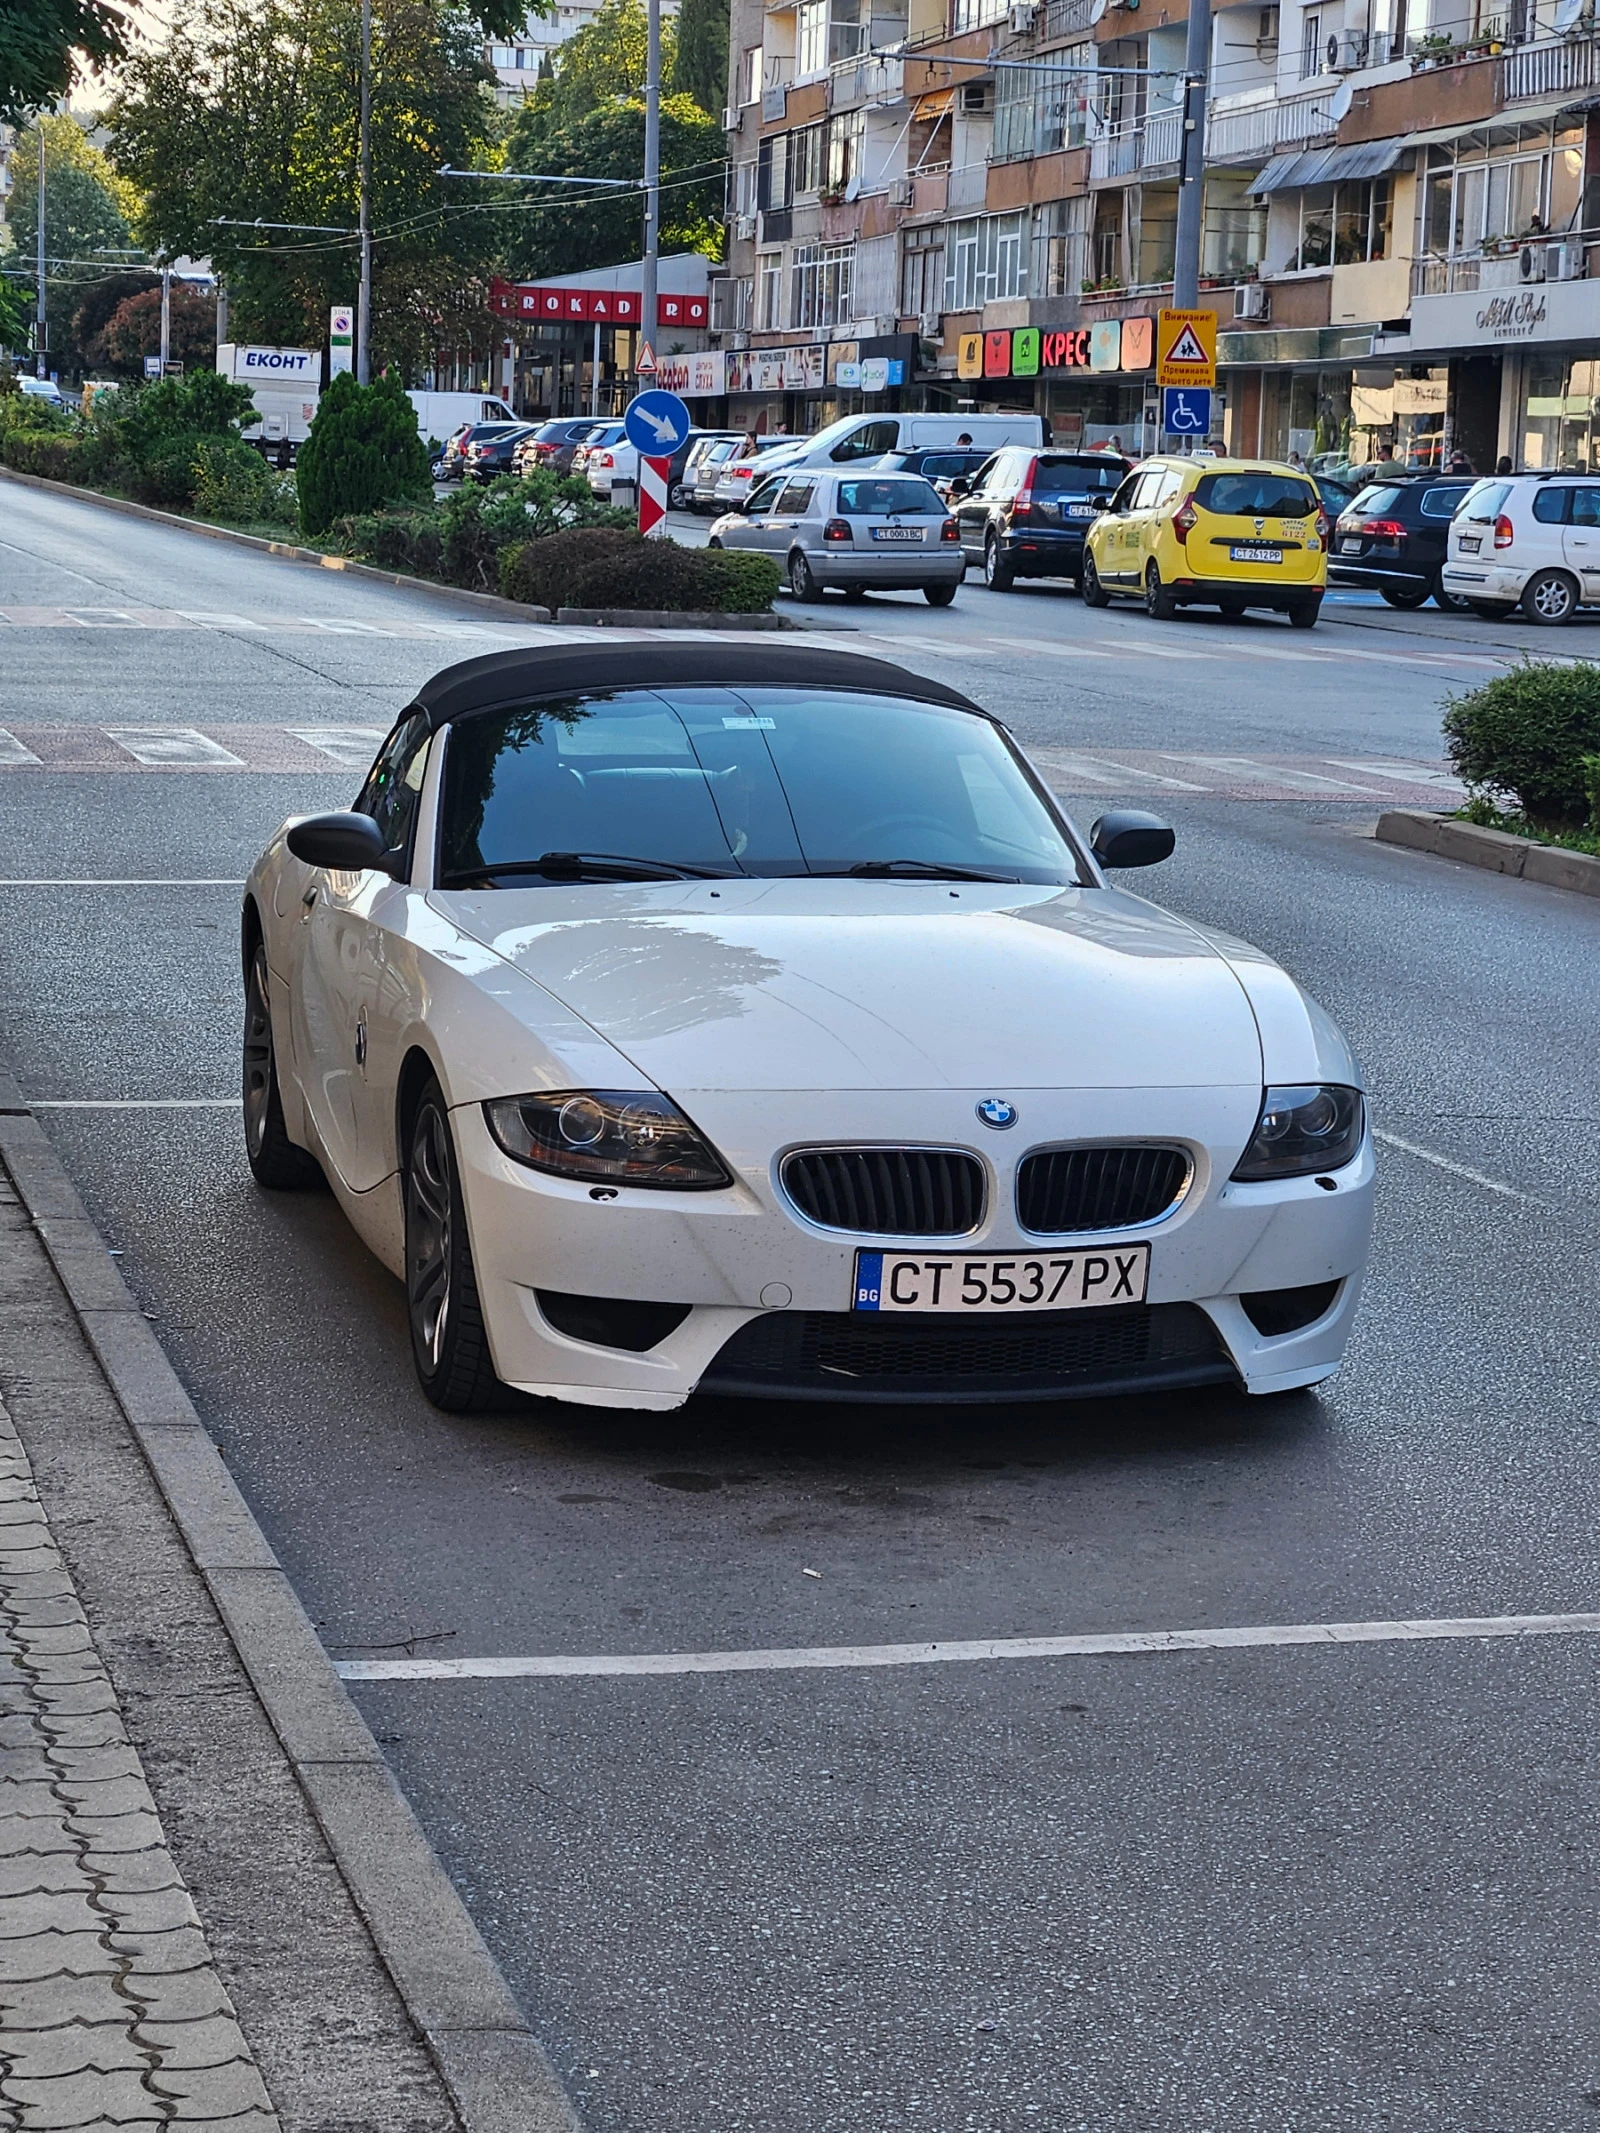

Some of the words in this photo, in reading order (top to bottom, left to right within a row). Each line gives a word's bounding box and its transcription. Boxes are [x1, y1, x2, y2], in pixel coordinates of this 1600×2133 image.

[246, 352, 308, 370] ЕКОНТ
[1164, 365, 1209, 375] Преминава
[890, 530, 909, 538] 0003
[1249, 549, 1269, 559] 2612
[858, 1288, 878, 1301] BG
[890, 1261, 953, 1306] CT
[961, 1259, 1074, 1305] 5537
[1081, 1254, 1138, 1300] PX
